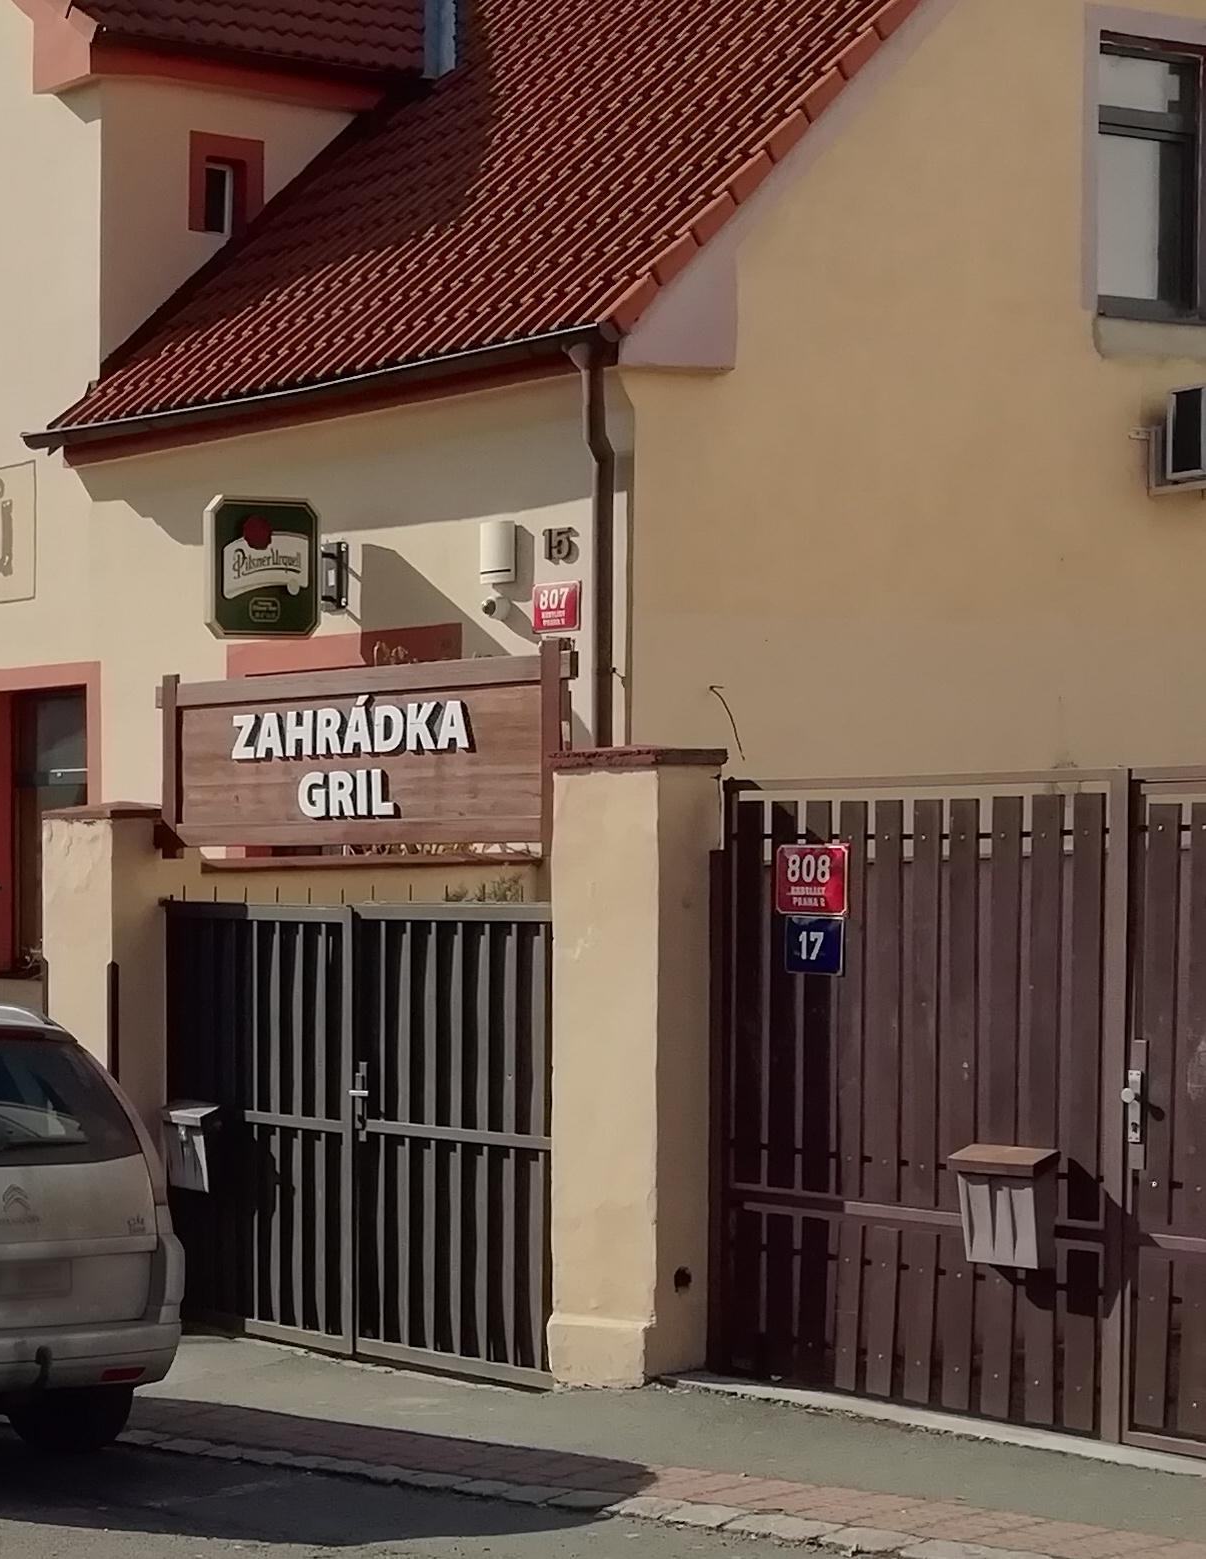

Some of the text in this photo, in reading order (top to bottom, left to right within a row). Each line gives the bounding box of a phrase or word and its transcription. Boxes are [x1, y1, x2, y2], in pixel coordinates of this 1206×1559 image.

[543, 527, 574, 562] 15
[539, 587, 570, 610] 807
[232, 695, 470, 761] ZAHRÁDKA
[298, 768, 395, 819] GRIL
[787, 854, 831, 883] 808
[798, 931, 824, 961] 17
